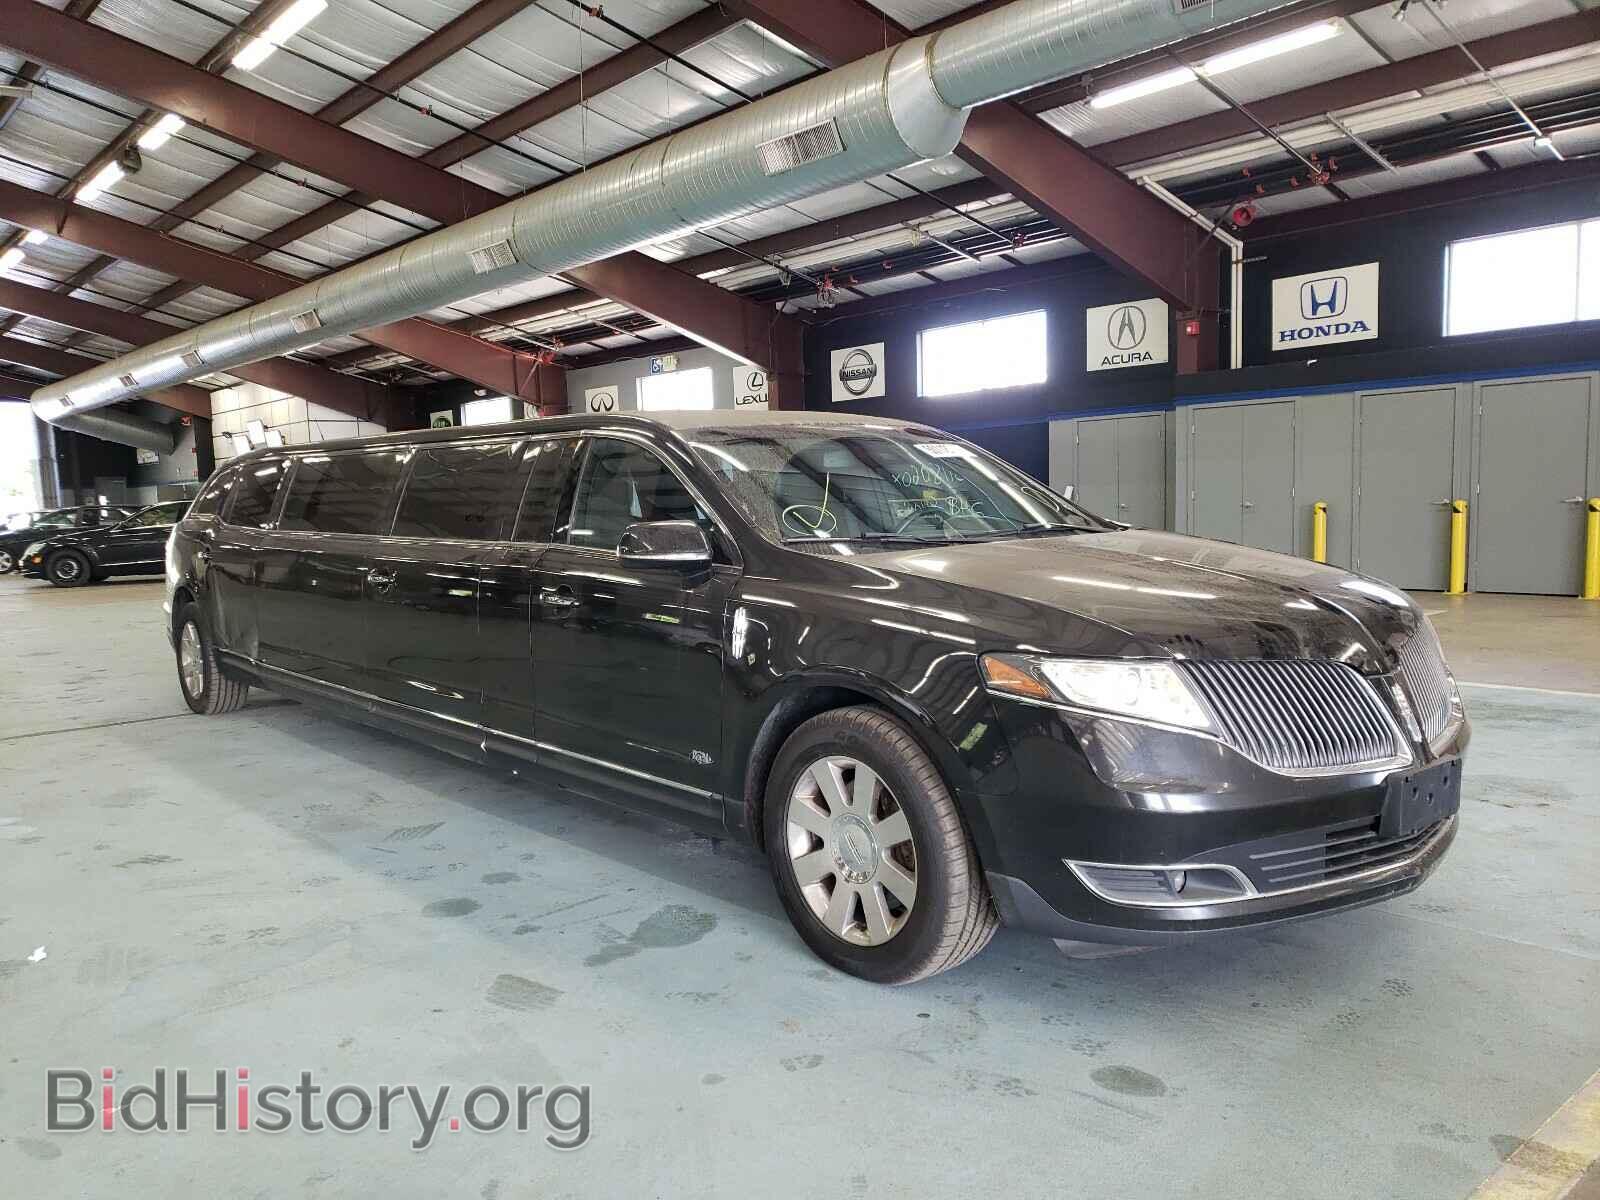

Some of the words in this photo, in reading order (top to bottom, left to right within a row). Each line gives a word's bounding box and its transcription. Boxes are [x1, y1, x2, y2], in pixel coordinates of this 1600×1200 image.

[1279, 320, 1371, 342] HONDA
[1101, 351, 1153, 367] ACURA
[843, 367, 873, 378] NISSAN
[735, 393, 768, 406] LEXU
